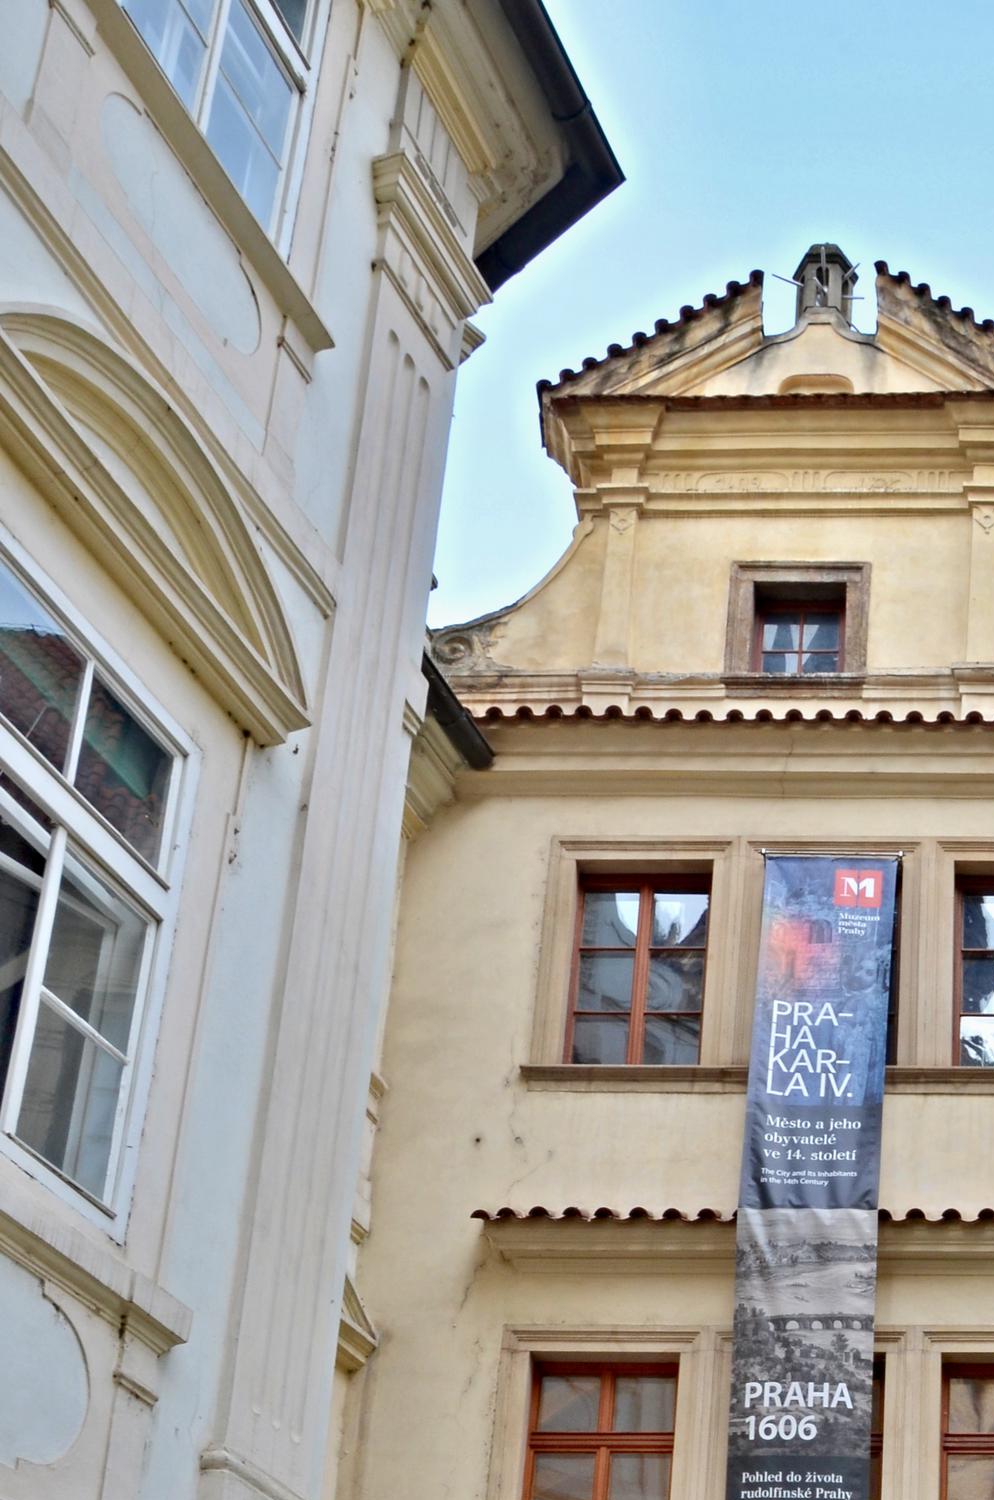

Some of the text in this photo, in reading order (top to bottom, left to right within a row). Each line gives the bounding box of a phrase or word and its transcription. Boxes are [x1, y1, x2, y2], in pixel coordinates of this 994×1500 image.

[839, 877, 875, 898] M
[838, 927, 865, 936] Prahy
[772, 999, 853, 1026] PRA-
[770, 1022, 817, 1050] HA
[768, 1046, 850, 1074] KAR-
[766, 1070, 853, 1097] LA IV.
[766, 1114, 862, 1131] Město a jeho
[764, 1132, 837, 1147] obyvatelé
[763, 1149, 857, 1160] ve 14. století
[761, 1168, 775, 1176] The
[776, 1169, 792, 1178] City
[800, 1178, 829, 1187] Century
[744, 1381, 853, 1409] PRAHA
[744, 1415, 818, 1441] 1606
[742, 1471, 843, 1483] Pohled do života
